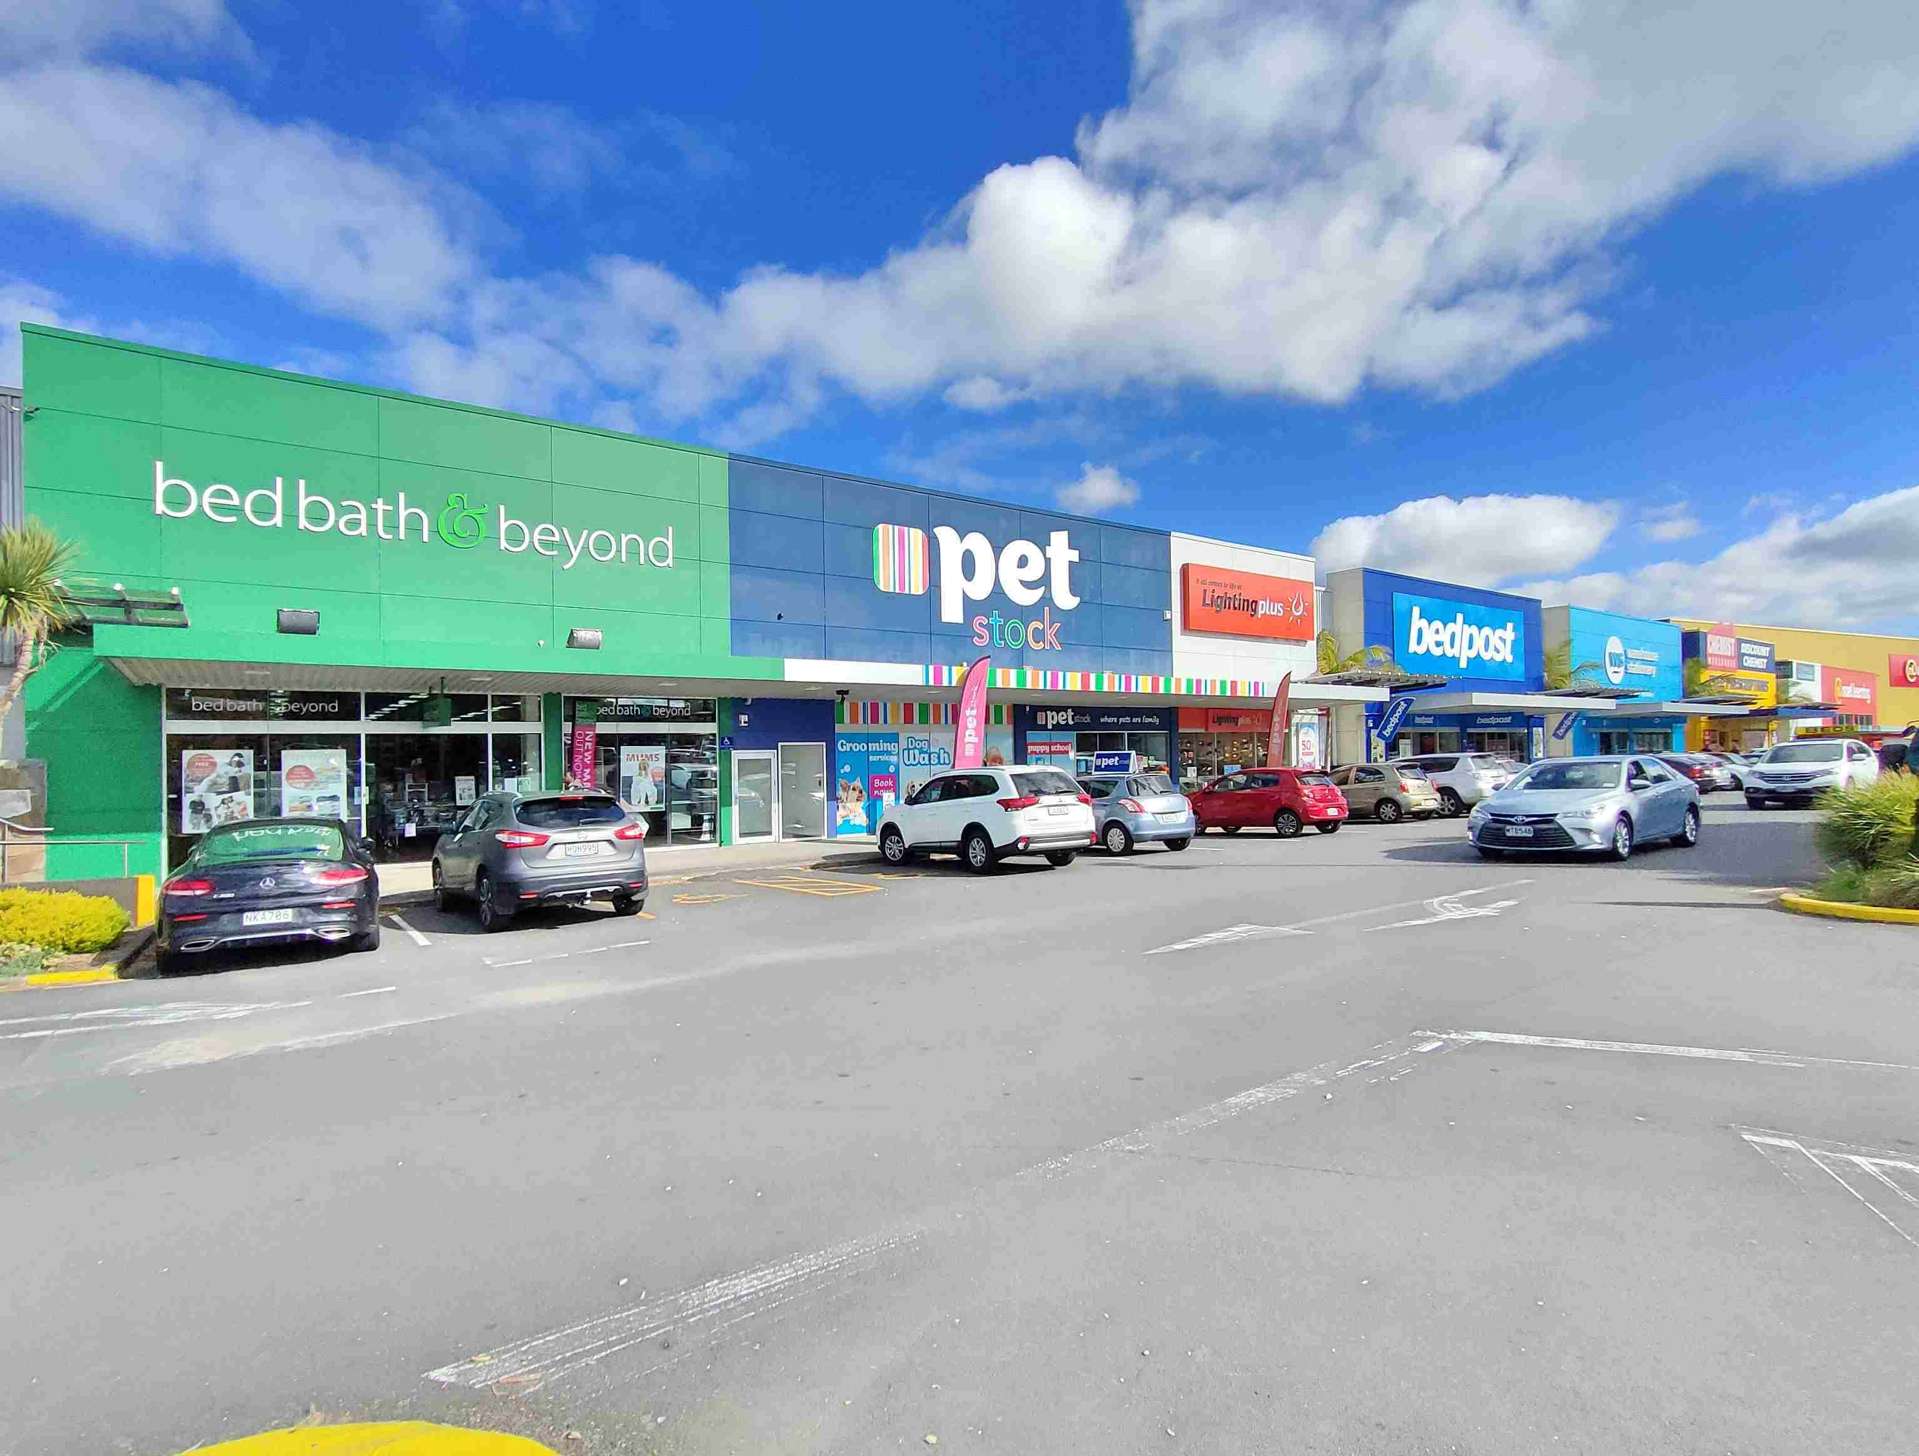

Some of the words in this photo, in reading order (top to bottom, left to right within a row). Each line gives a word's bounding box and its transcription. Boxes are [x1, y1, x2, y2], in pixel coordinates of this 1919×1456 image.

[153, 461, 283, 527] bed
[297, 479, 429, 541] bath
[437, 492, 487, 549] &
[498, 504, 674, 570] beyond
[933, 525, 1081, 624] pet
[972, 606, 1062, 650] stock
[1408, 605, 1516, 669] bedpost
[192, 699, 224, 712] bed
[226, 699, 263, 712] bath
[616, 701, 641, 716] bath
[652, 703, 691, 718] beyond
[1100, 715, 1117, 723] where
[1382, 701, 1408, 738] bedpost
[575, 731, 585, 753] OUT
[584, 731, 594, 764] NEW
[837, 739, 899, 754] Grooming
[908, 737, 928, 751] Dog
[1027, 744, 1049, 754] puppy
[1050, 743, 1072, 752] school
[902, 747, 950, 767] Wash
[1101, 756, 1119, 768] pet
[873, 778, 894, 788] Book
